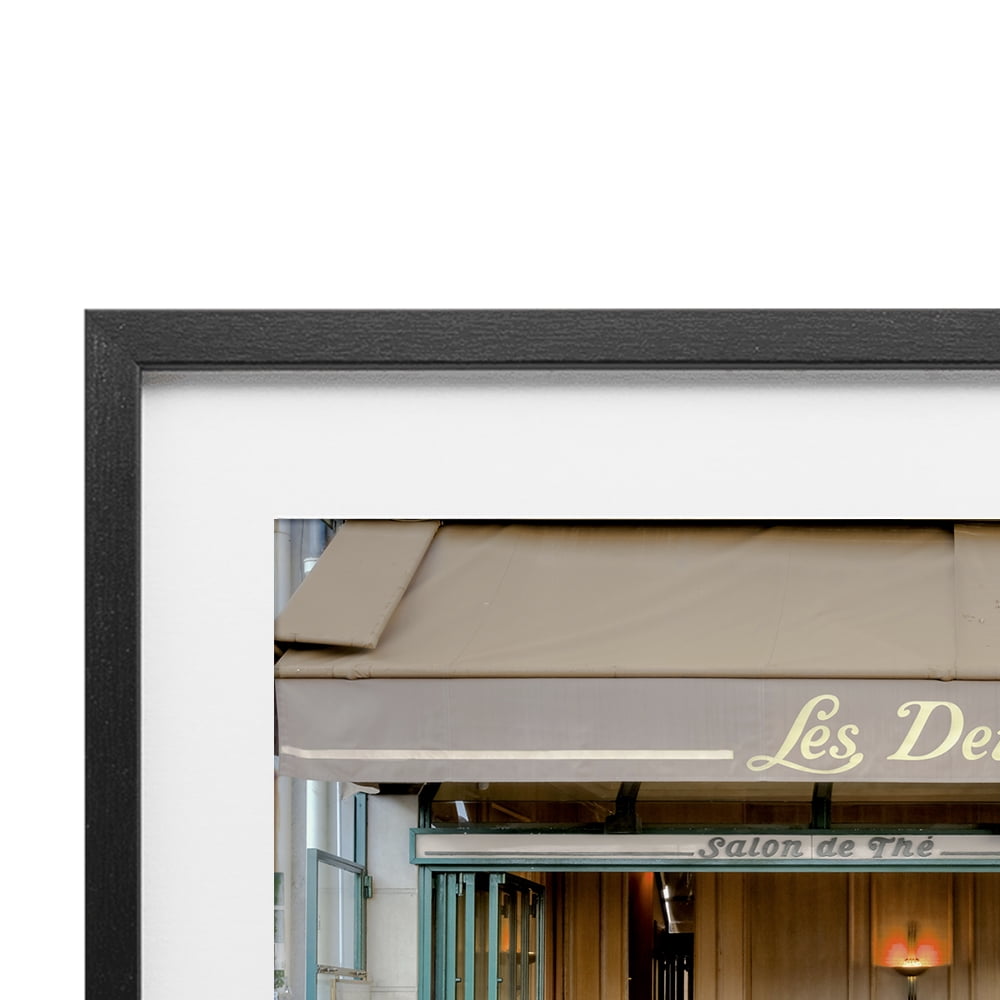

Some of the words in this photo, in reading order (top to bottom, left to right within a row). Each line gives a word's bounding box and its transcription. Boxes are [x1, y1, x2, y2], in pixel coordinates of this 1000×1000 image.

[747, 694, 865, 775] Les
[699, 836, 804, 858] Salon
[815, 836, 856, 858] de
[867, 835, 935, 859] Thé
